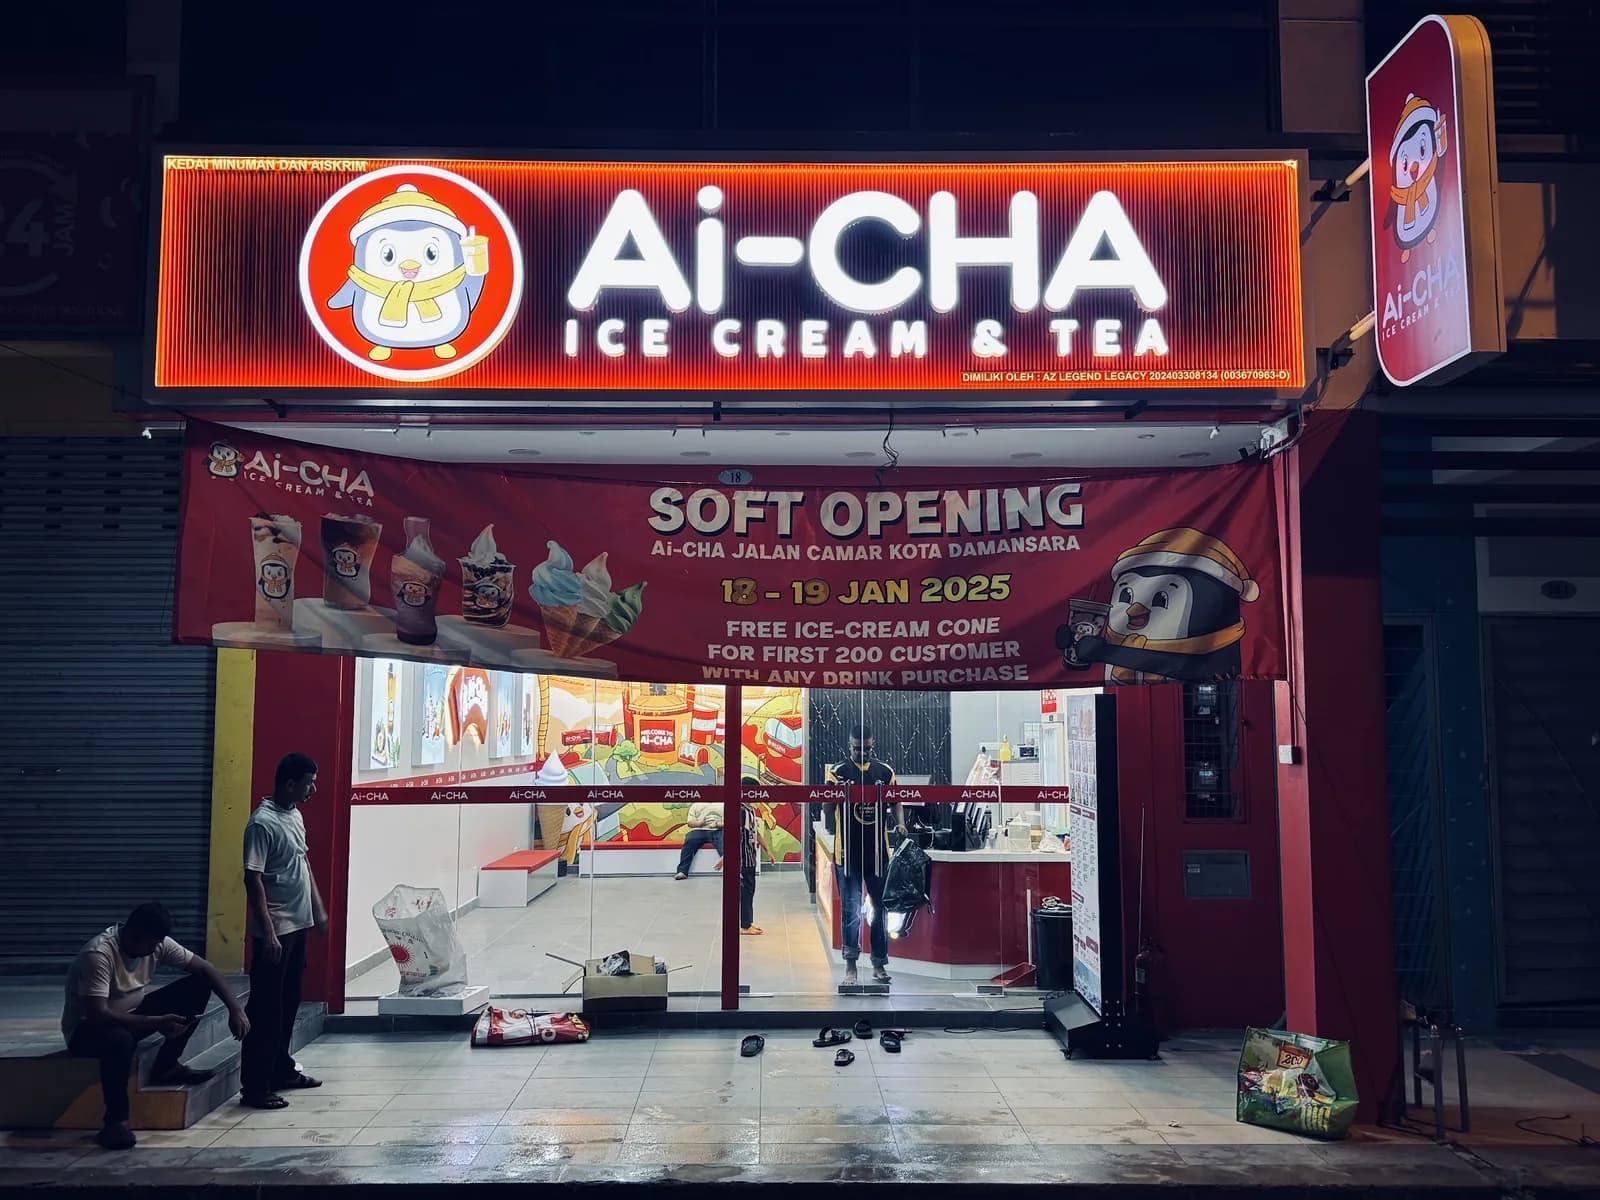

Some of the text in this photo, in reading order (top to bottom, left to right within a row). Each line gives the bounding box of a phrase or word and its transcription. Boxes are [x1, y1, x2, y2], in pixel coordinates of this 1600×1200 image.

[167, 158, 366, 172] KEDAI MINUMAN DAN AISKRIM
[568, 185, 1168, 314] Ai-CHA
[1382, 251, 1461, 329] Ai-CHA
[1382, 325, 1397, 341] ICE
[1400, 304, 1430, 329] CREAM
[564, 318, 1168, 358] ICE CREAM & TEA
[962, 372, 1004, 382] DIMILIKI
[1006, 372, 1034, 382] OLEH
[1042, 372, 1057, 382] AZ
[1058, 371, 1102, 381] LEGEND
[1104, 371, 1147, 381] LEGACY
[1149, 370, 1218, 381] 202403308134
[243, 470, 266, 482] ICE
[244, 450, 375, 498] Ai-CHA
[730, 471, 742, 484] 18
[647, 482, 1085, 539] SOFT OPENING
[650, 535, 1081, 561] Ai-CHA JALAN CAMAR KOTA DAMANSARA
[790, 578, 831, 606] 19
[837, 578, 910, 605] JAN
[919, 572, 1012, 604] 2025
[725, 616, 1001, 639] FREE ICE-CREAM CONE
[706, 640, 1021, 664] FOR FIRST 200 CUSTOMER
[701, 664, 1030, 686] WITH ANY DRINK PURCHASE
[640, 736, 673, 746] Ai-CHA
[351, 792, 389, 801] Ai-CHA
[430, 791, 469, 800] Ai-CHA
[509, 790, 547, 800] Ai-CHA
[587, 790, 624, 799] Ai-CHA
[664, 790, 701, 799] Ai-CHA
[740, 790, 770, 799] i-CHA
[809, 790, 846, 798] Ai-CHA
[885, 789, 922, 798] Ai-CHA
[961, 789, 998, 799] Ai-CHA
